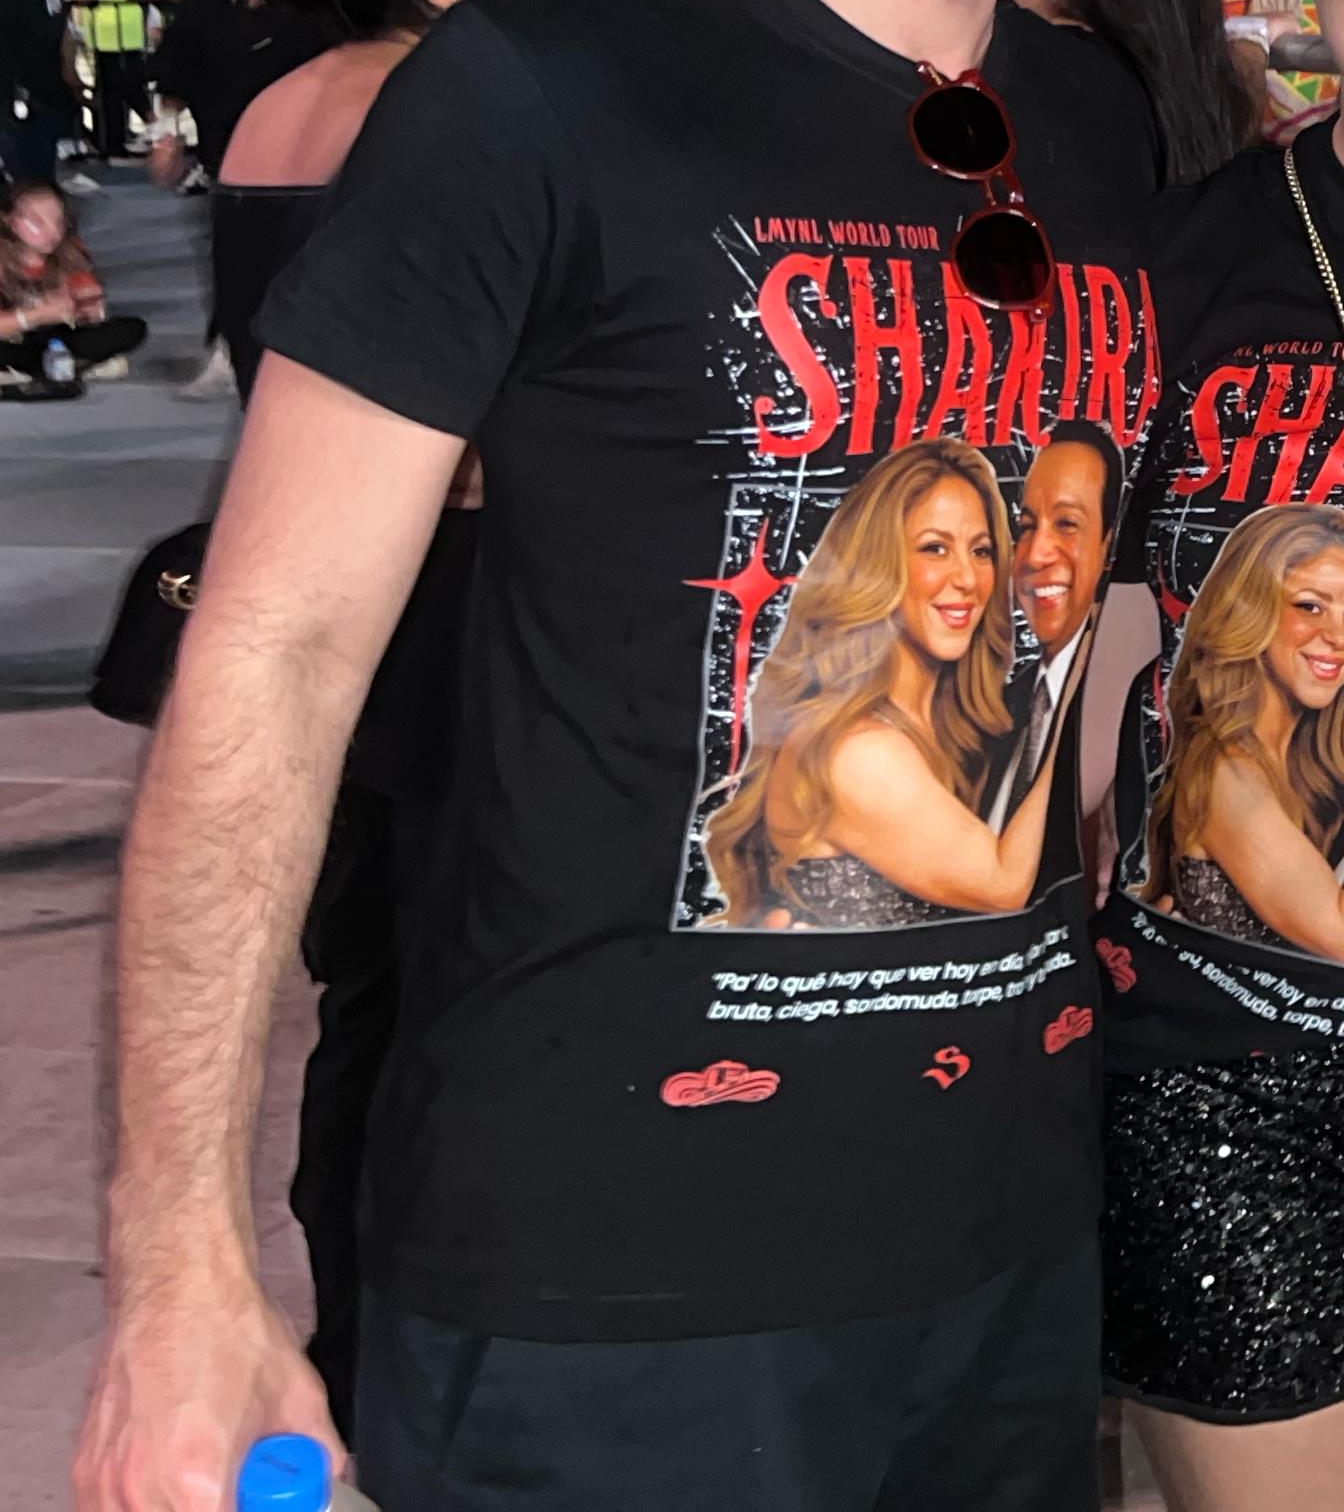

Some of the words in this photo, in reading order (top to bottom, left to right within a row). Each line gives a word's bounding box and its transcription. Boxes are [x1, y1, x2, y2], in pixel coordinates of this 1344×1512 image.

[754, 216, 823, 244] LMYNL
[828, 219, 892, 248] WORLD
[895, 224, 940, 251] TOUR
[1262, 341, 1324, 356] WORLD
[754, 972, 779, 992] lo
[780, 971, 828, 998] qué
[827, 970, 869, 991] hay
[868, 968, 907, 990] que
[907, 965, 943, 983] ver
[941, 961, 980, 984] hoy
[1253, 969, 1279, 988] ver
[1273, 978, 1305, 1006] hoy
[1303, 996, 1330, 1008] en
[706, 1000, 773, 1023] bruta,
[774, 1000, 842, 1022] ciega,
[842, 990, 960, 1014] sordomuda,
